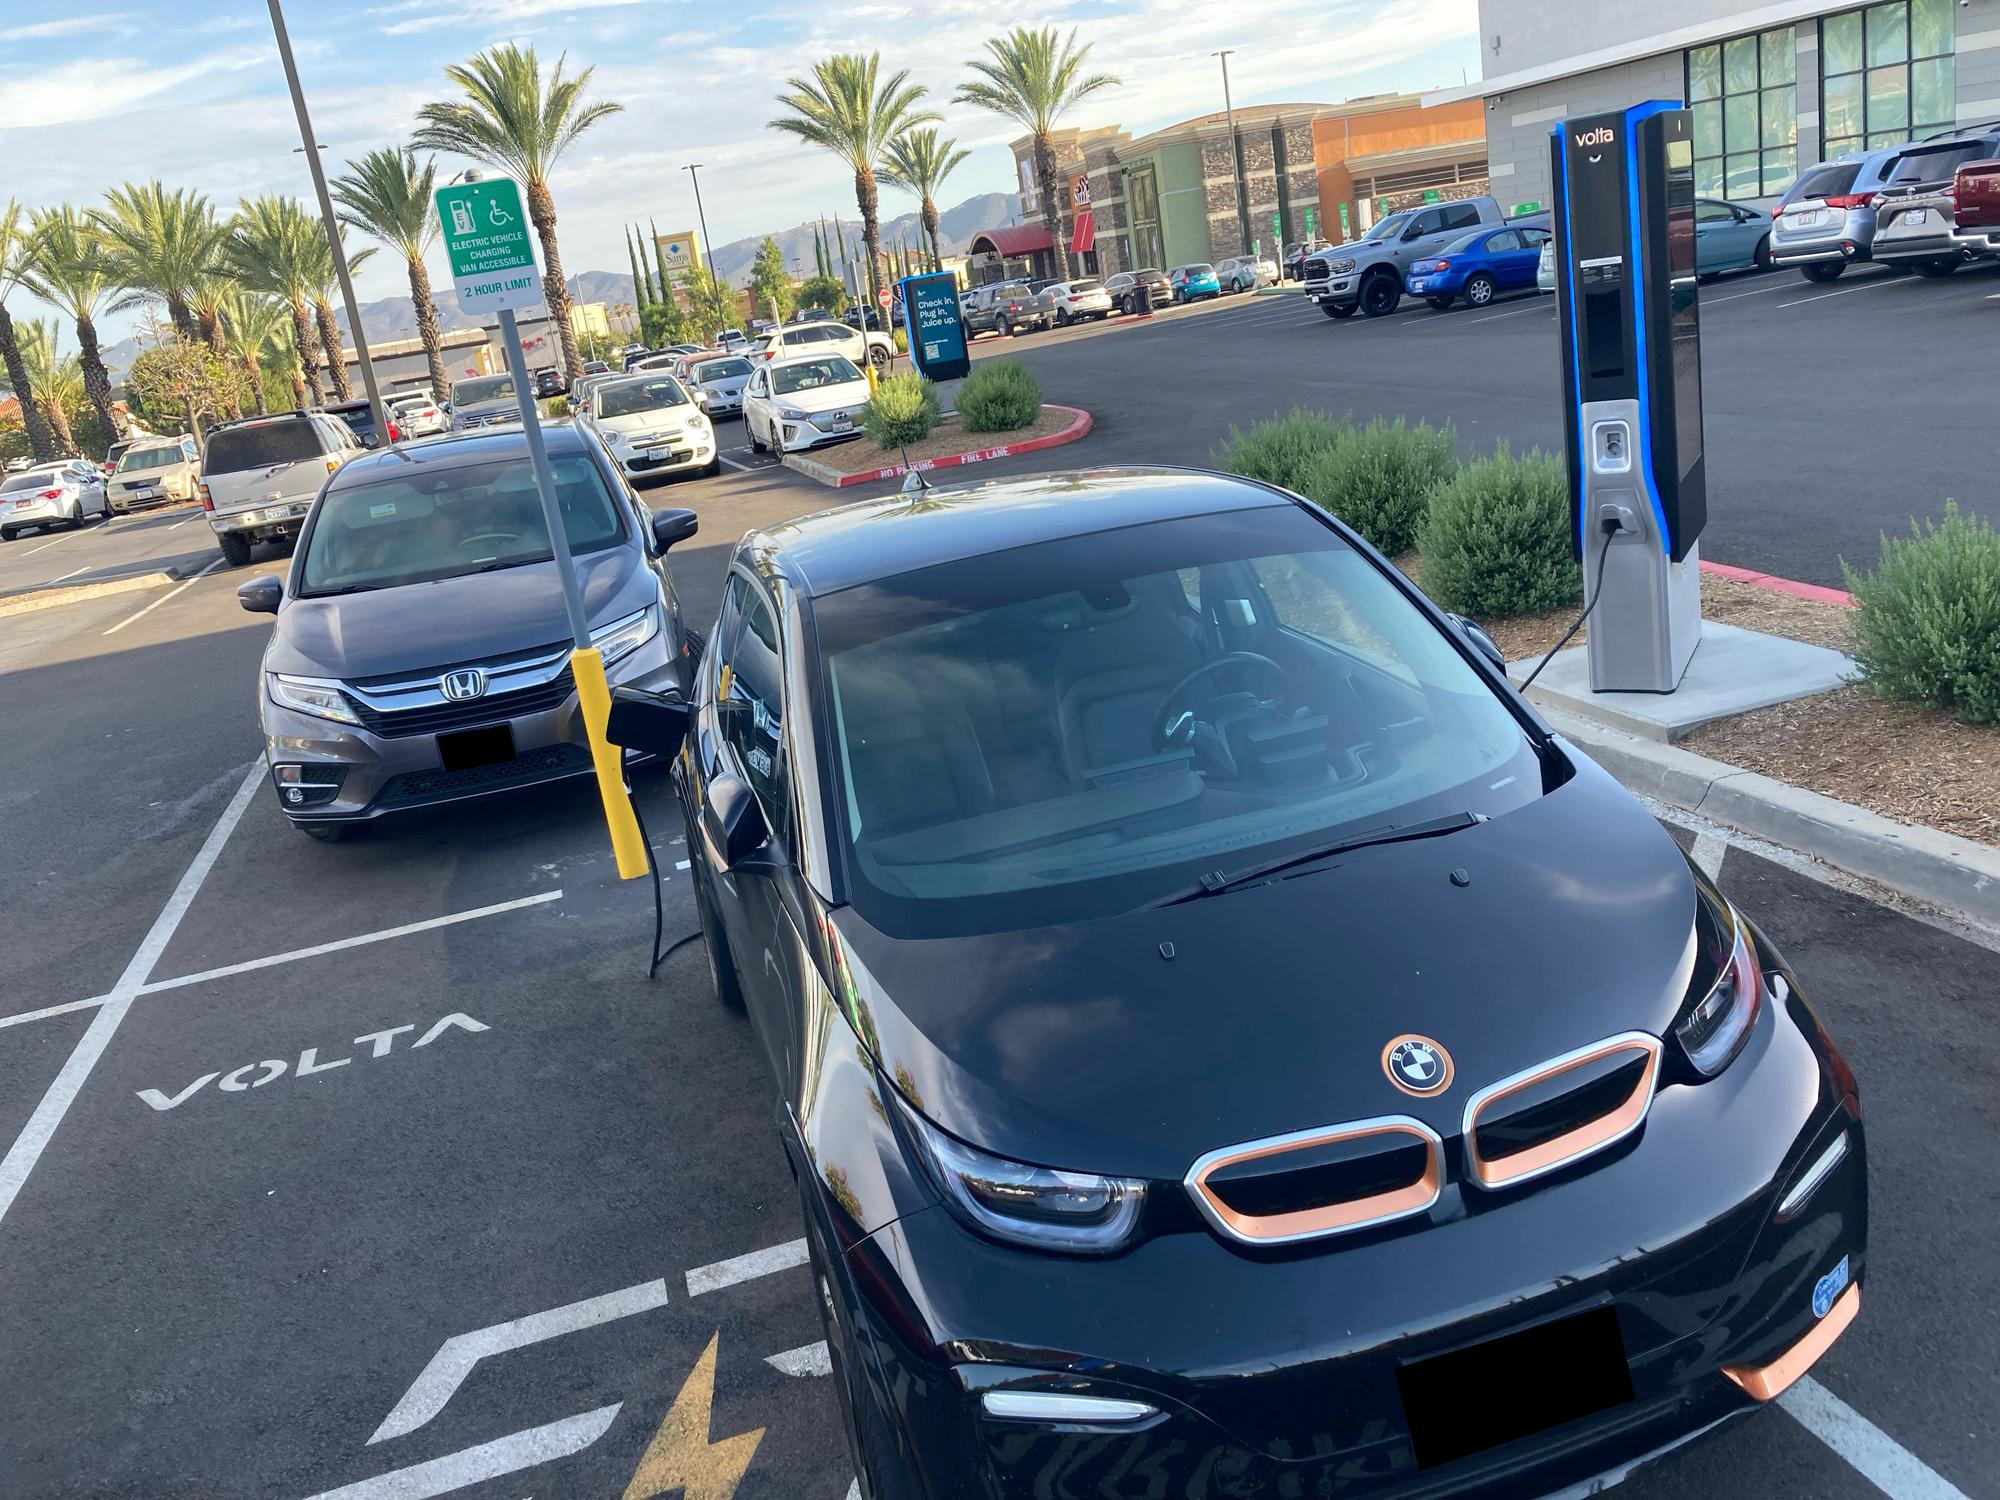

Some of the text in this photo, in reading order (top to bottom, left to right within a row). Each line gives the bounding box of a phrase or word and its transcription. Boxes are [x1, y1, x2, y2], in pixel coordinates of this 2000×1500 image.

[1575, 127, 1615, 147] volta
[452, 231, 523, 250] ELECTRIC VEHICLE
[470, 245, 511, 260] CHARGING
[460, 255, 526, 273] VAN ACCESSIBLE
[464, 276, 532, 298] 2 HOUR LIMIT
[918, 298, 943, 309] Check
[920, 309, 937, 319] Plug
[921, 317, 957, 328] Juice up.
[880, 468, 894, 479] NO
[961, 452, 983, 464] FIRE
[986, 446, 1010, 459] LANE
[136, 1012, 492, 1111] VOLTA
[1392, 1042, 1433, 1062] BMW
